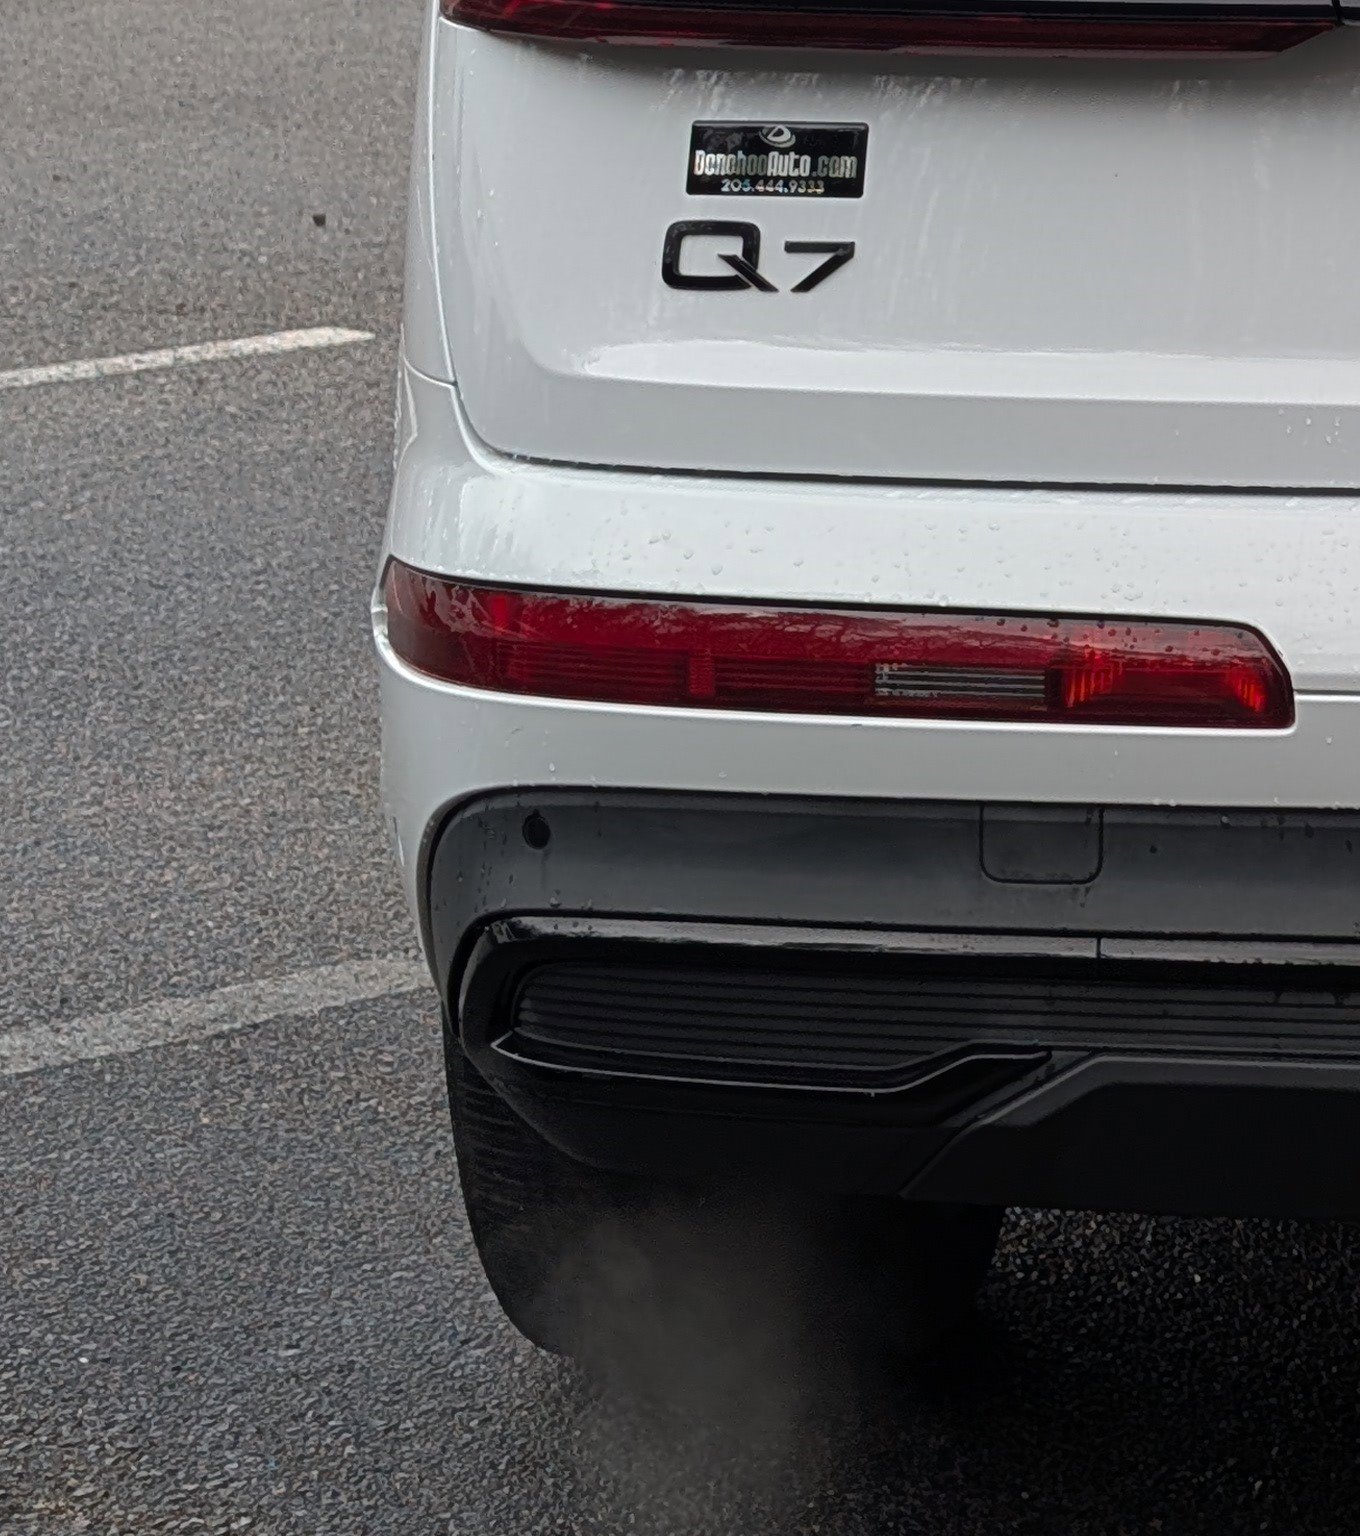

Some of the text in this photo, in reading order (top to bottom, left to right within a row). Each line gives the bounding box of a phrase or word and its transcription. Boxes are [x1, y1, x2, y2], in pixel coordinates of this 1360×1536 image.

[694, 149, 858, 179] DonohooAuto.com
[720, 178, 825, 194] 205.444.9333
[661, 220, 856, 293] Q7
